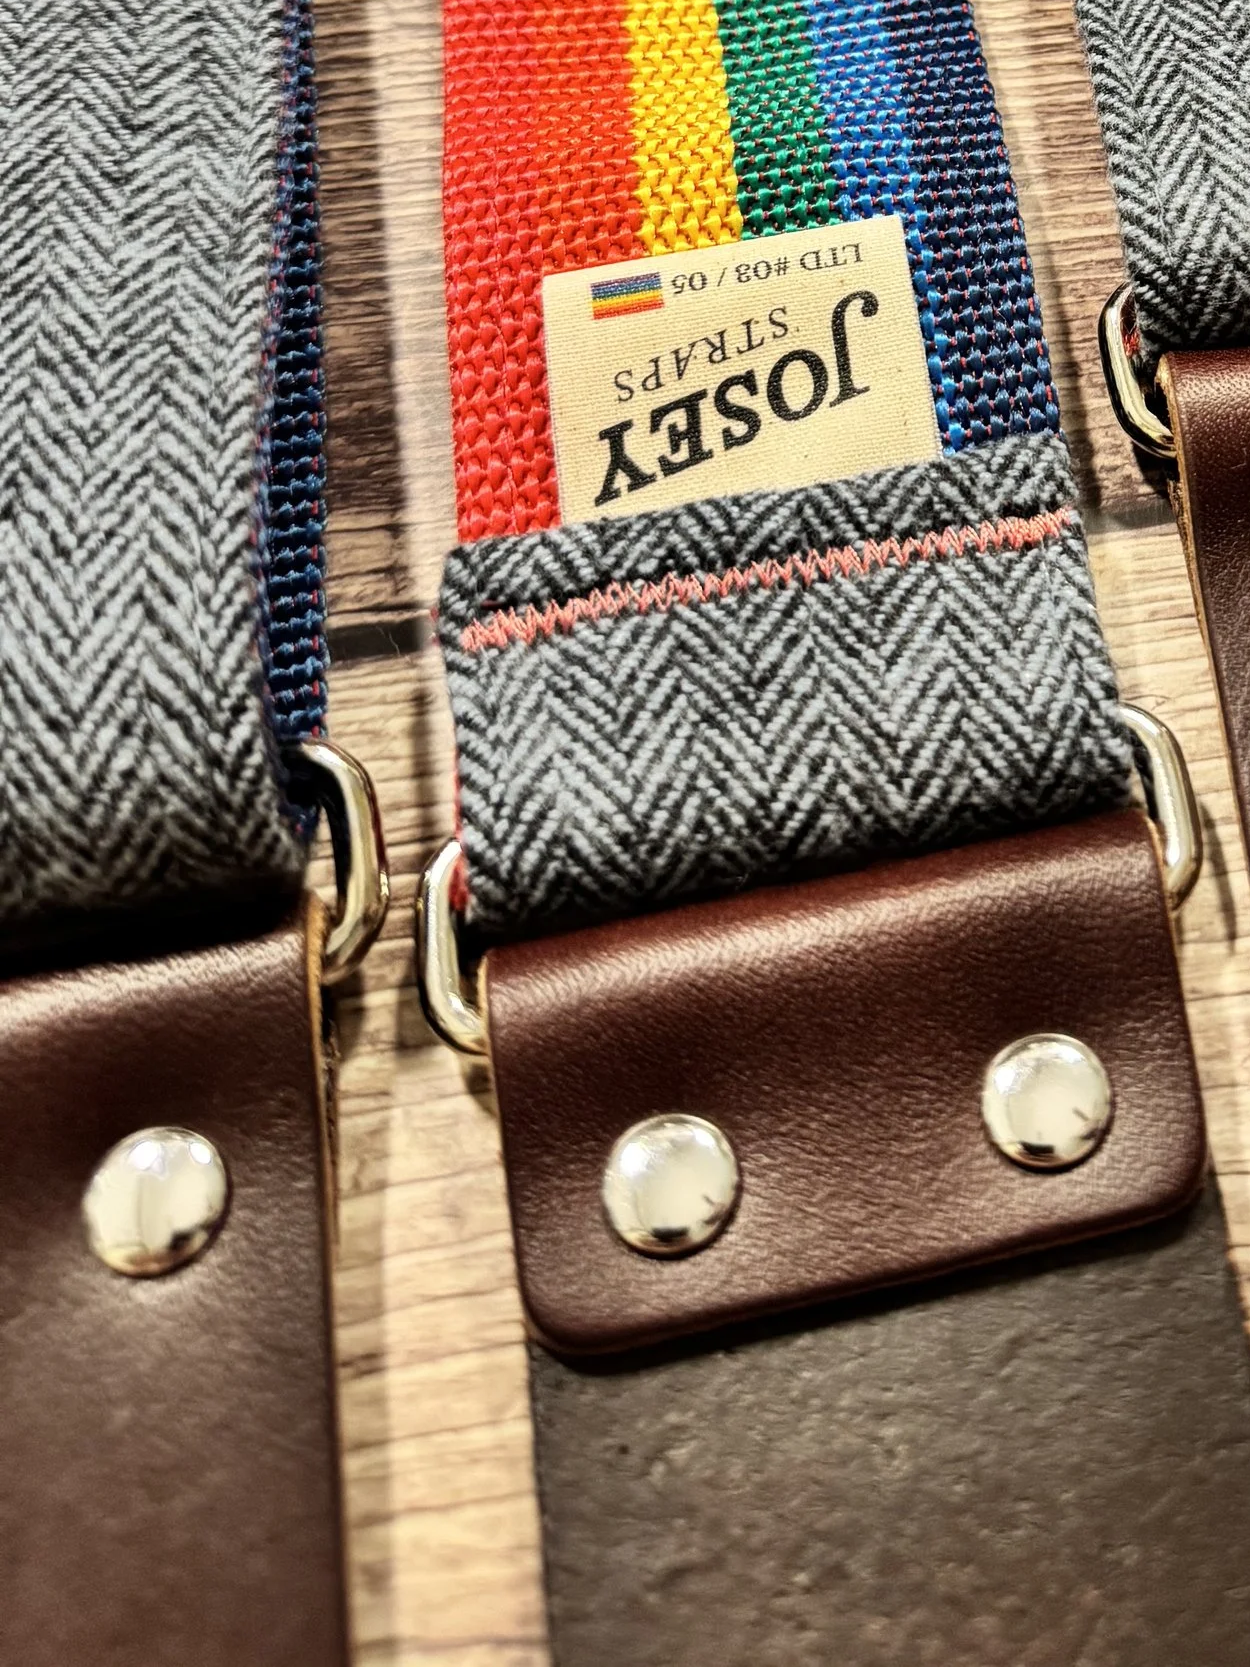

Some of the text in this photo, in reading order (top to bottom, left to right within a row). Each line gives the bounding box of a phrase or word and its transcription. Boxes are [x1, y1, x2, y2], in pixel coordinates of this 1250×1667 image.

[671, 273, 709, 294] 05
[800, 243, 863, 271] LTD
[614, 306, 789, 402] STRAPS
[595, 290, 879, 506] JOSEY
